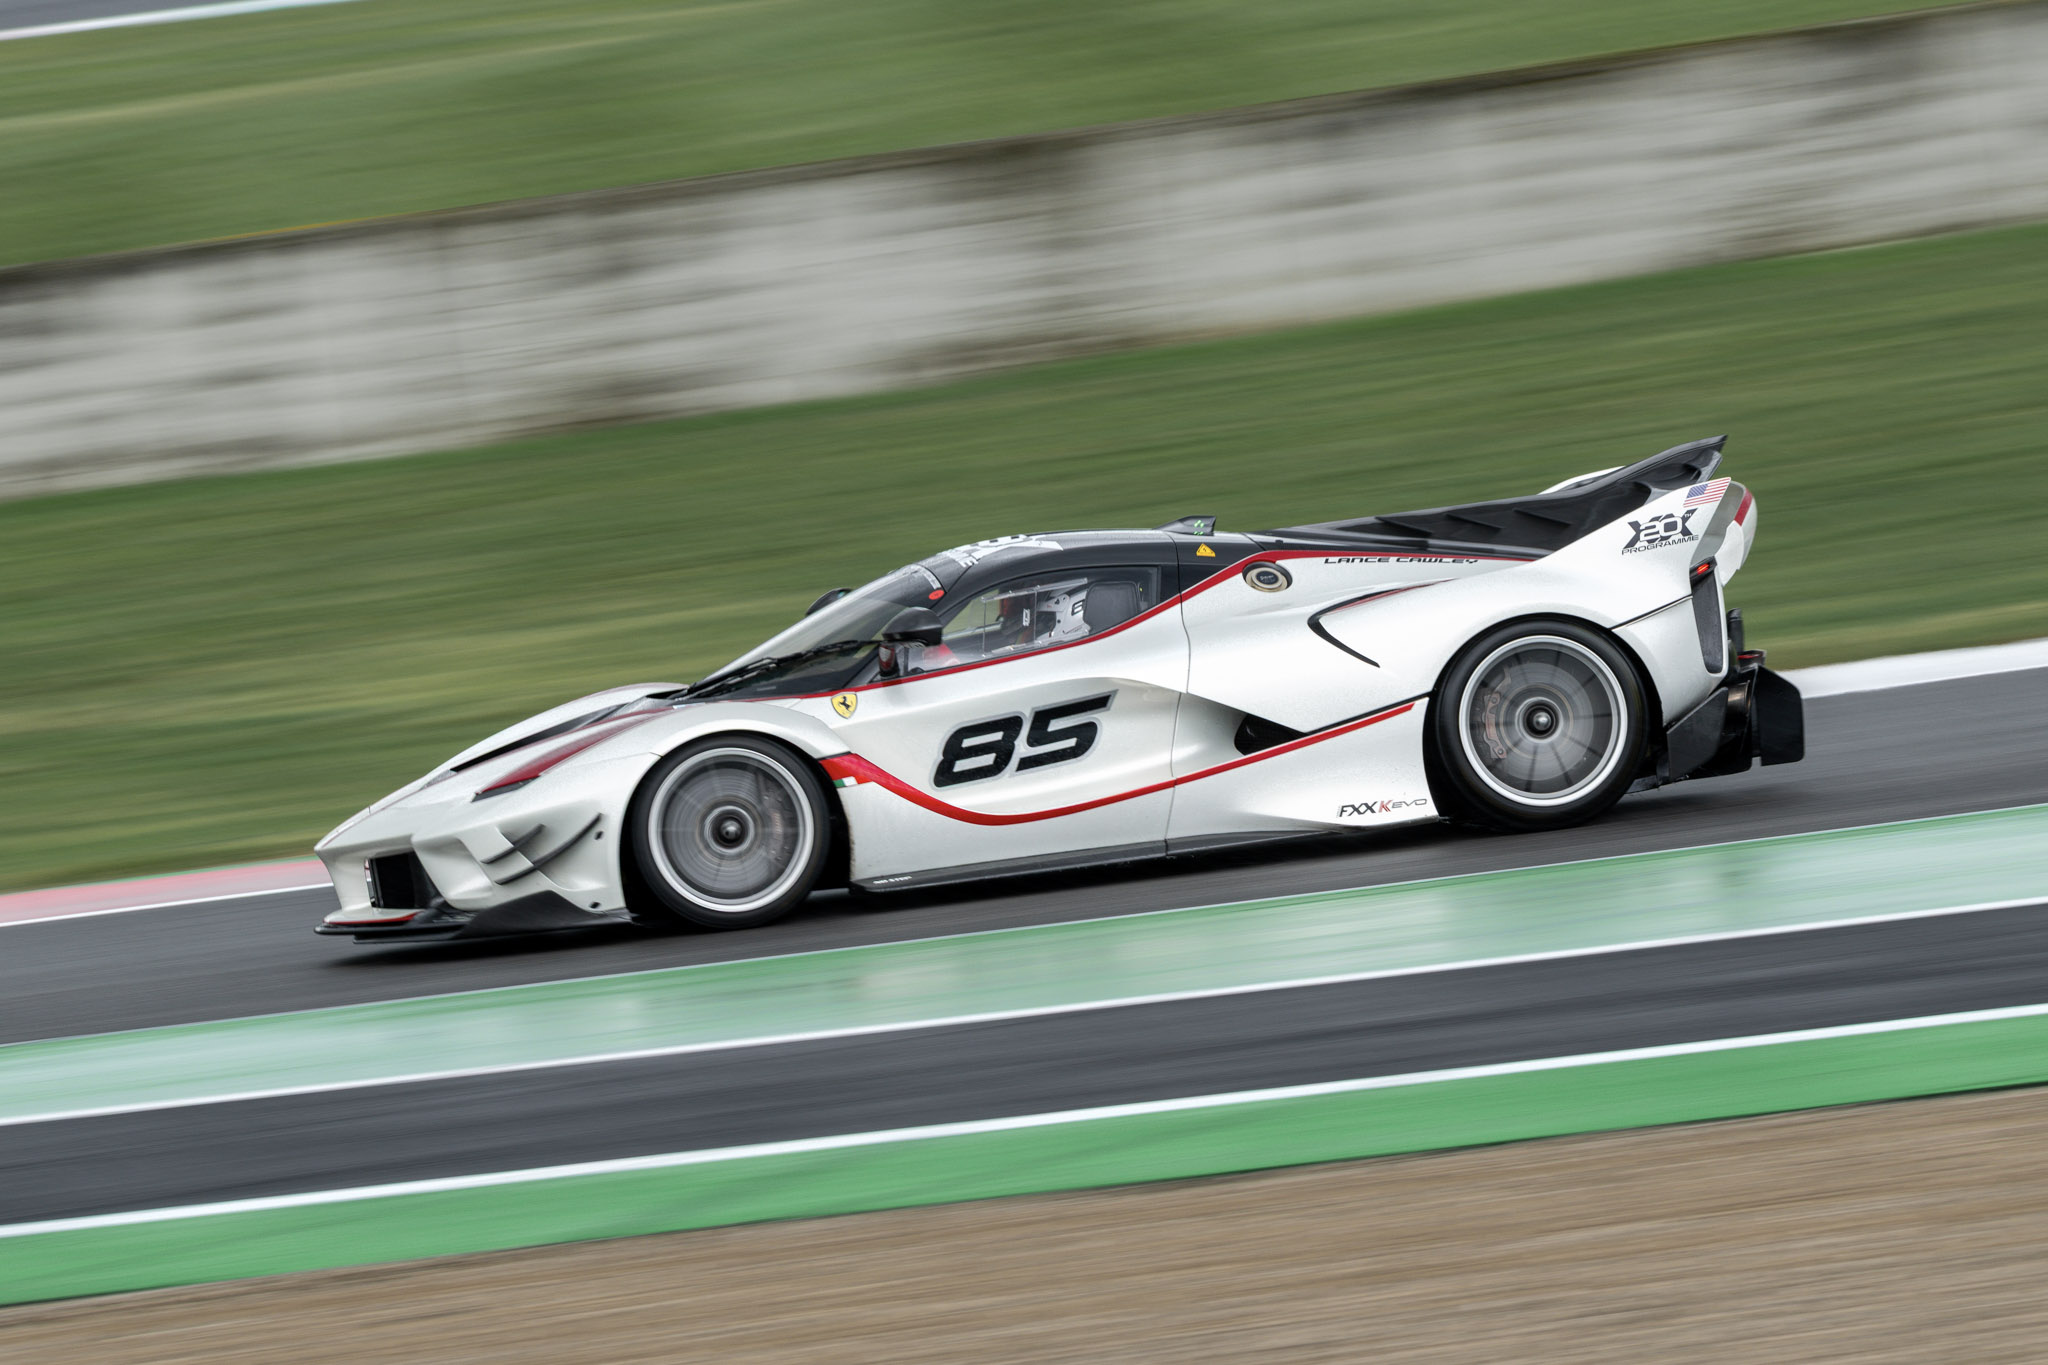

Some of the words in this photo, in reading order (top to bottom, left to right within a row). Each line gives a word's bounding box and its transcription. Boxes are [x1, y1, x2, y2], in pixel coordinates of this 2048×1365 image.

[1621, 534, 1699, 555] PROGRAMME
[935, 694, 1112, 788] 85
[1339, 801, 1378, 817] FXX
[1391, 798, 1427, 809] EVO
